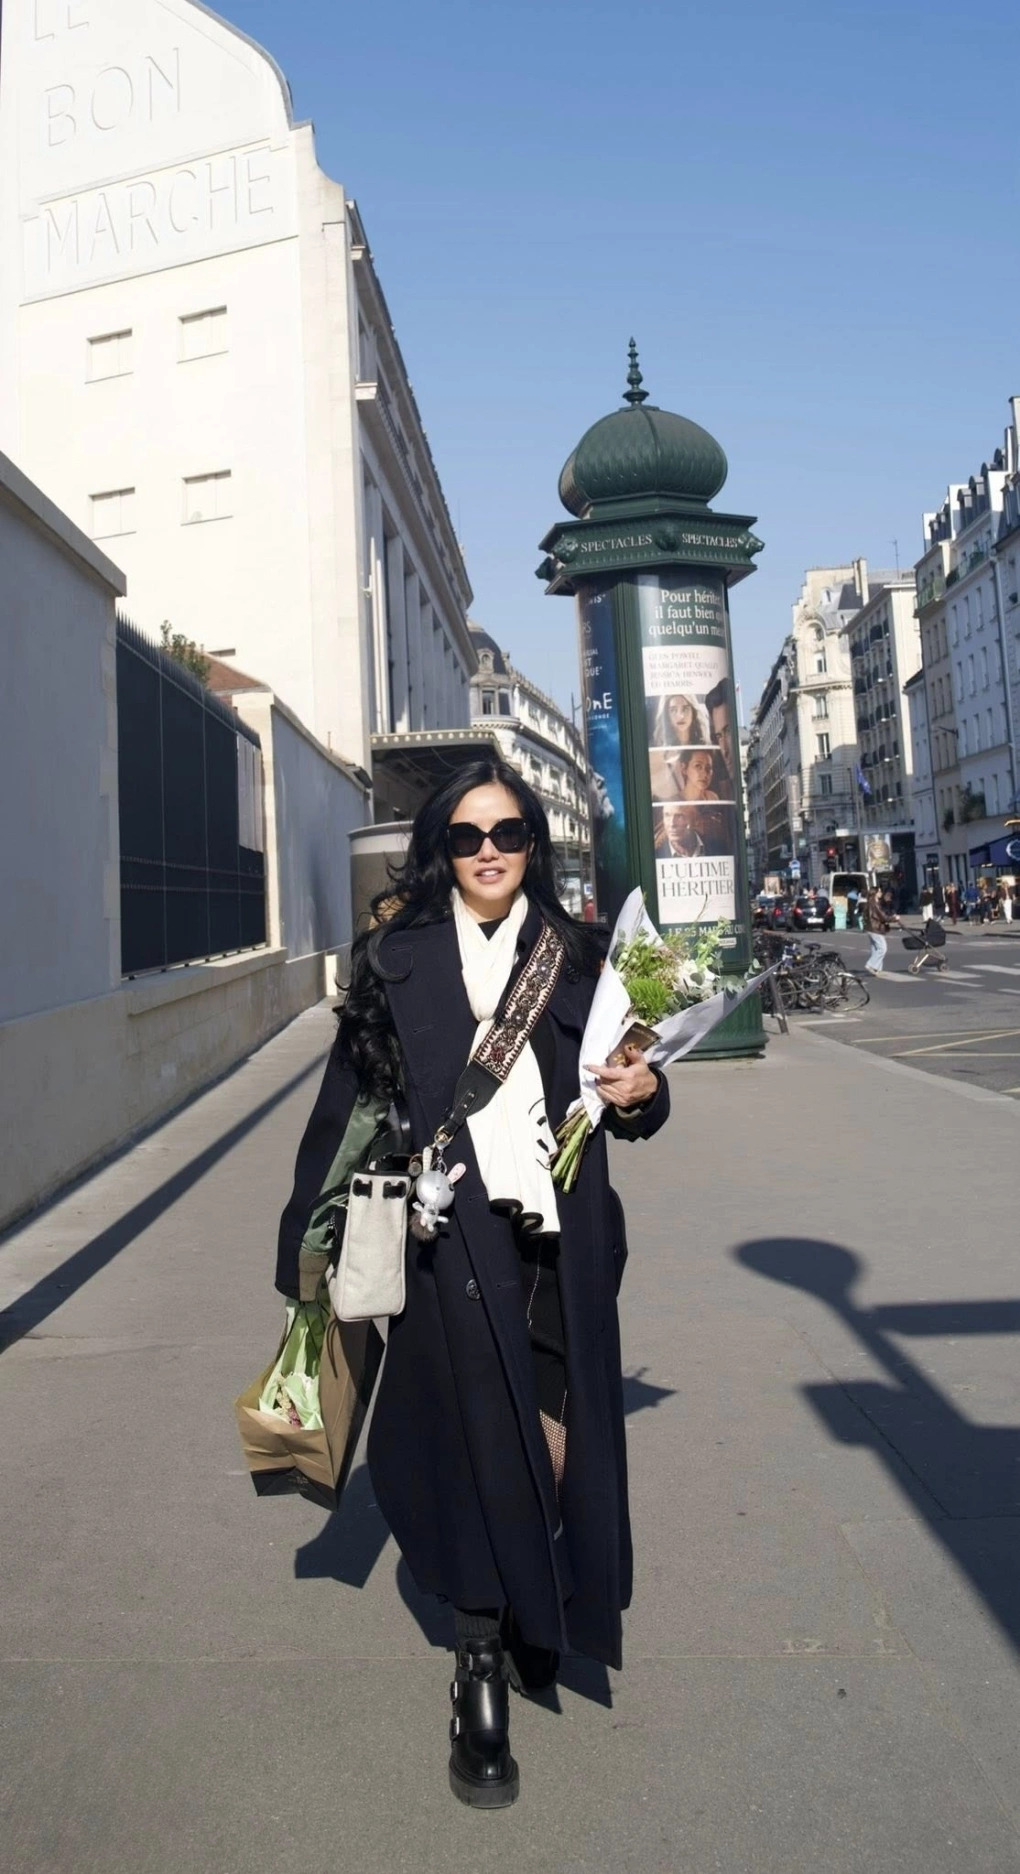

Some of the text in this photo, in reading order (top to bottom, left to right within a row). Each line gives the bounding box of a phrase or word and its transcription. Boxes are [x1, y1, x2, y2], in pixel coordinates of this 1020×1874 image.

[44, 46, 181, 148] BON
[580, 534, 653, 553] SPECTACLES
[682, 533, 738, 548] SPECTACLES
[661, 589, 692, 603] Pour
[654, 605, 664, 619] il
[667, 605, 693, 619] faut
[694, 605, 715, 620] bien
[648, 620, 710, 638] quelqu'un
[661, 861, 730, 880] L'ULTIME
